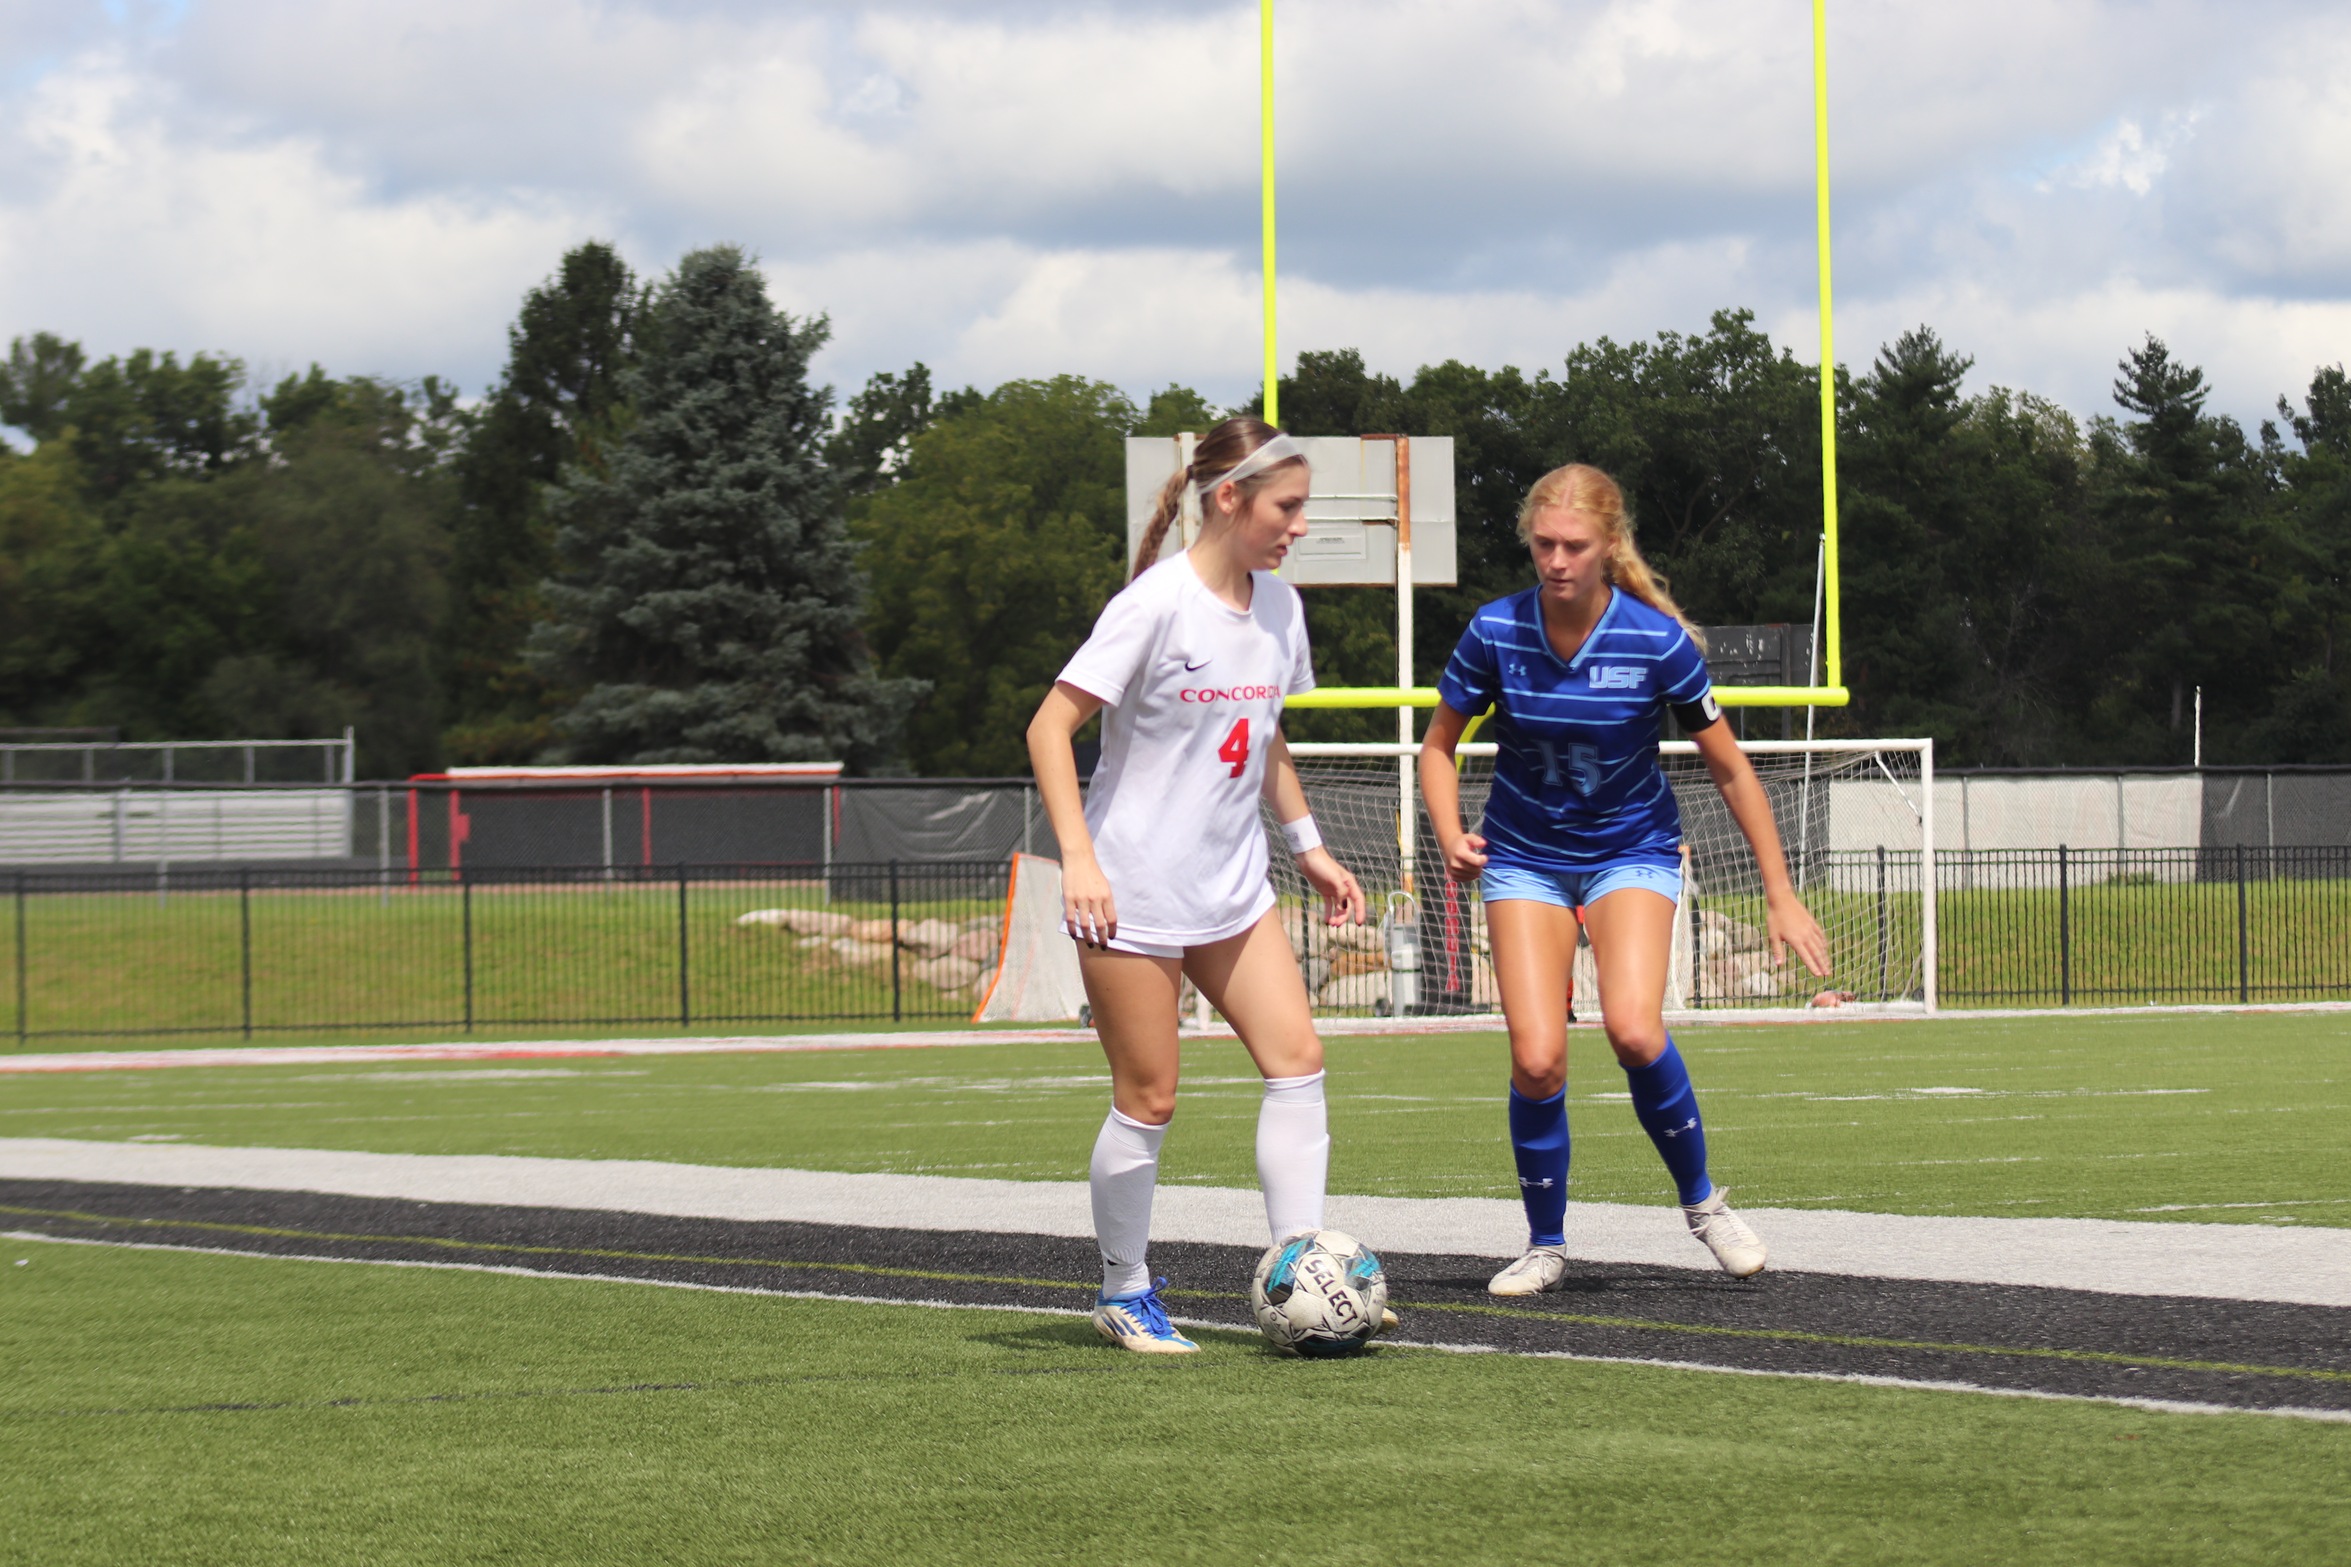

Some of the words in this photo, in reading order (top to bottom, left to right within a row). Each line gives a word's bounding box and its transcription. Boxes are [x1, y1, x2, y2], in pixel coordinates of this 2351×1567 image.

[1588, 665, 1648, 689] USF
[1218, 718, 1249, 778] 4
[1530, 739, 1601, 797] 15
[1304, 1259, 1358, 1325] SELECT
